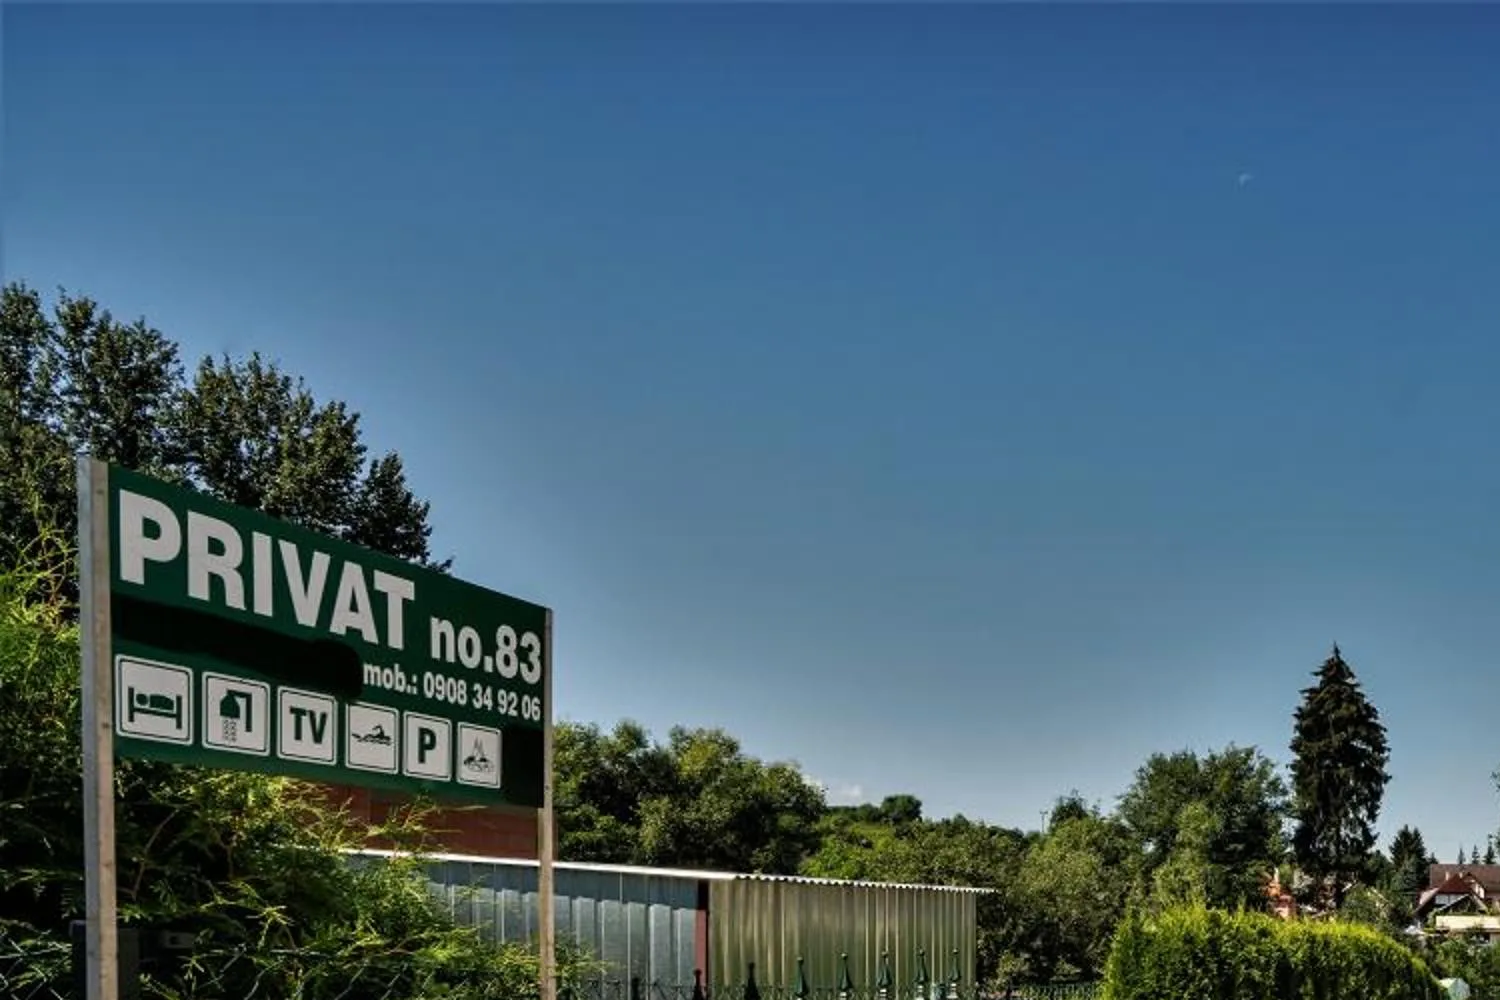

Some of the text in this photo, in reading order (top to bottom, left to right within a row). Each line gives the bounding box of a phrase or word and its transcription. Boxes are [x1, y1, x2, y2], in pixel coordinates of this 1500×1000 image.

[119, 489, 415, 650] PRIVAT
[363, 663, 541, 721] mob.: 0908 34 92 06
[289, 706, 327, 744] TV
[418, 727, 436, 764] P
